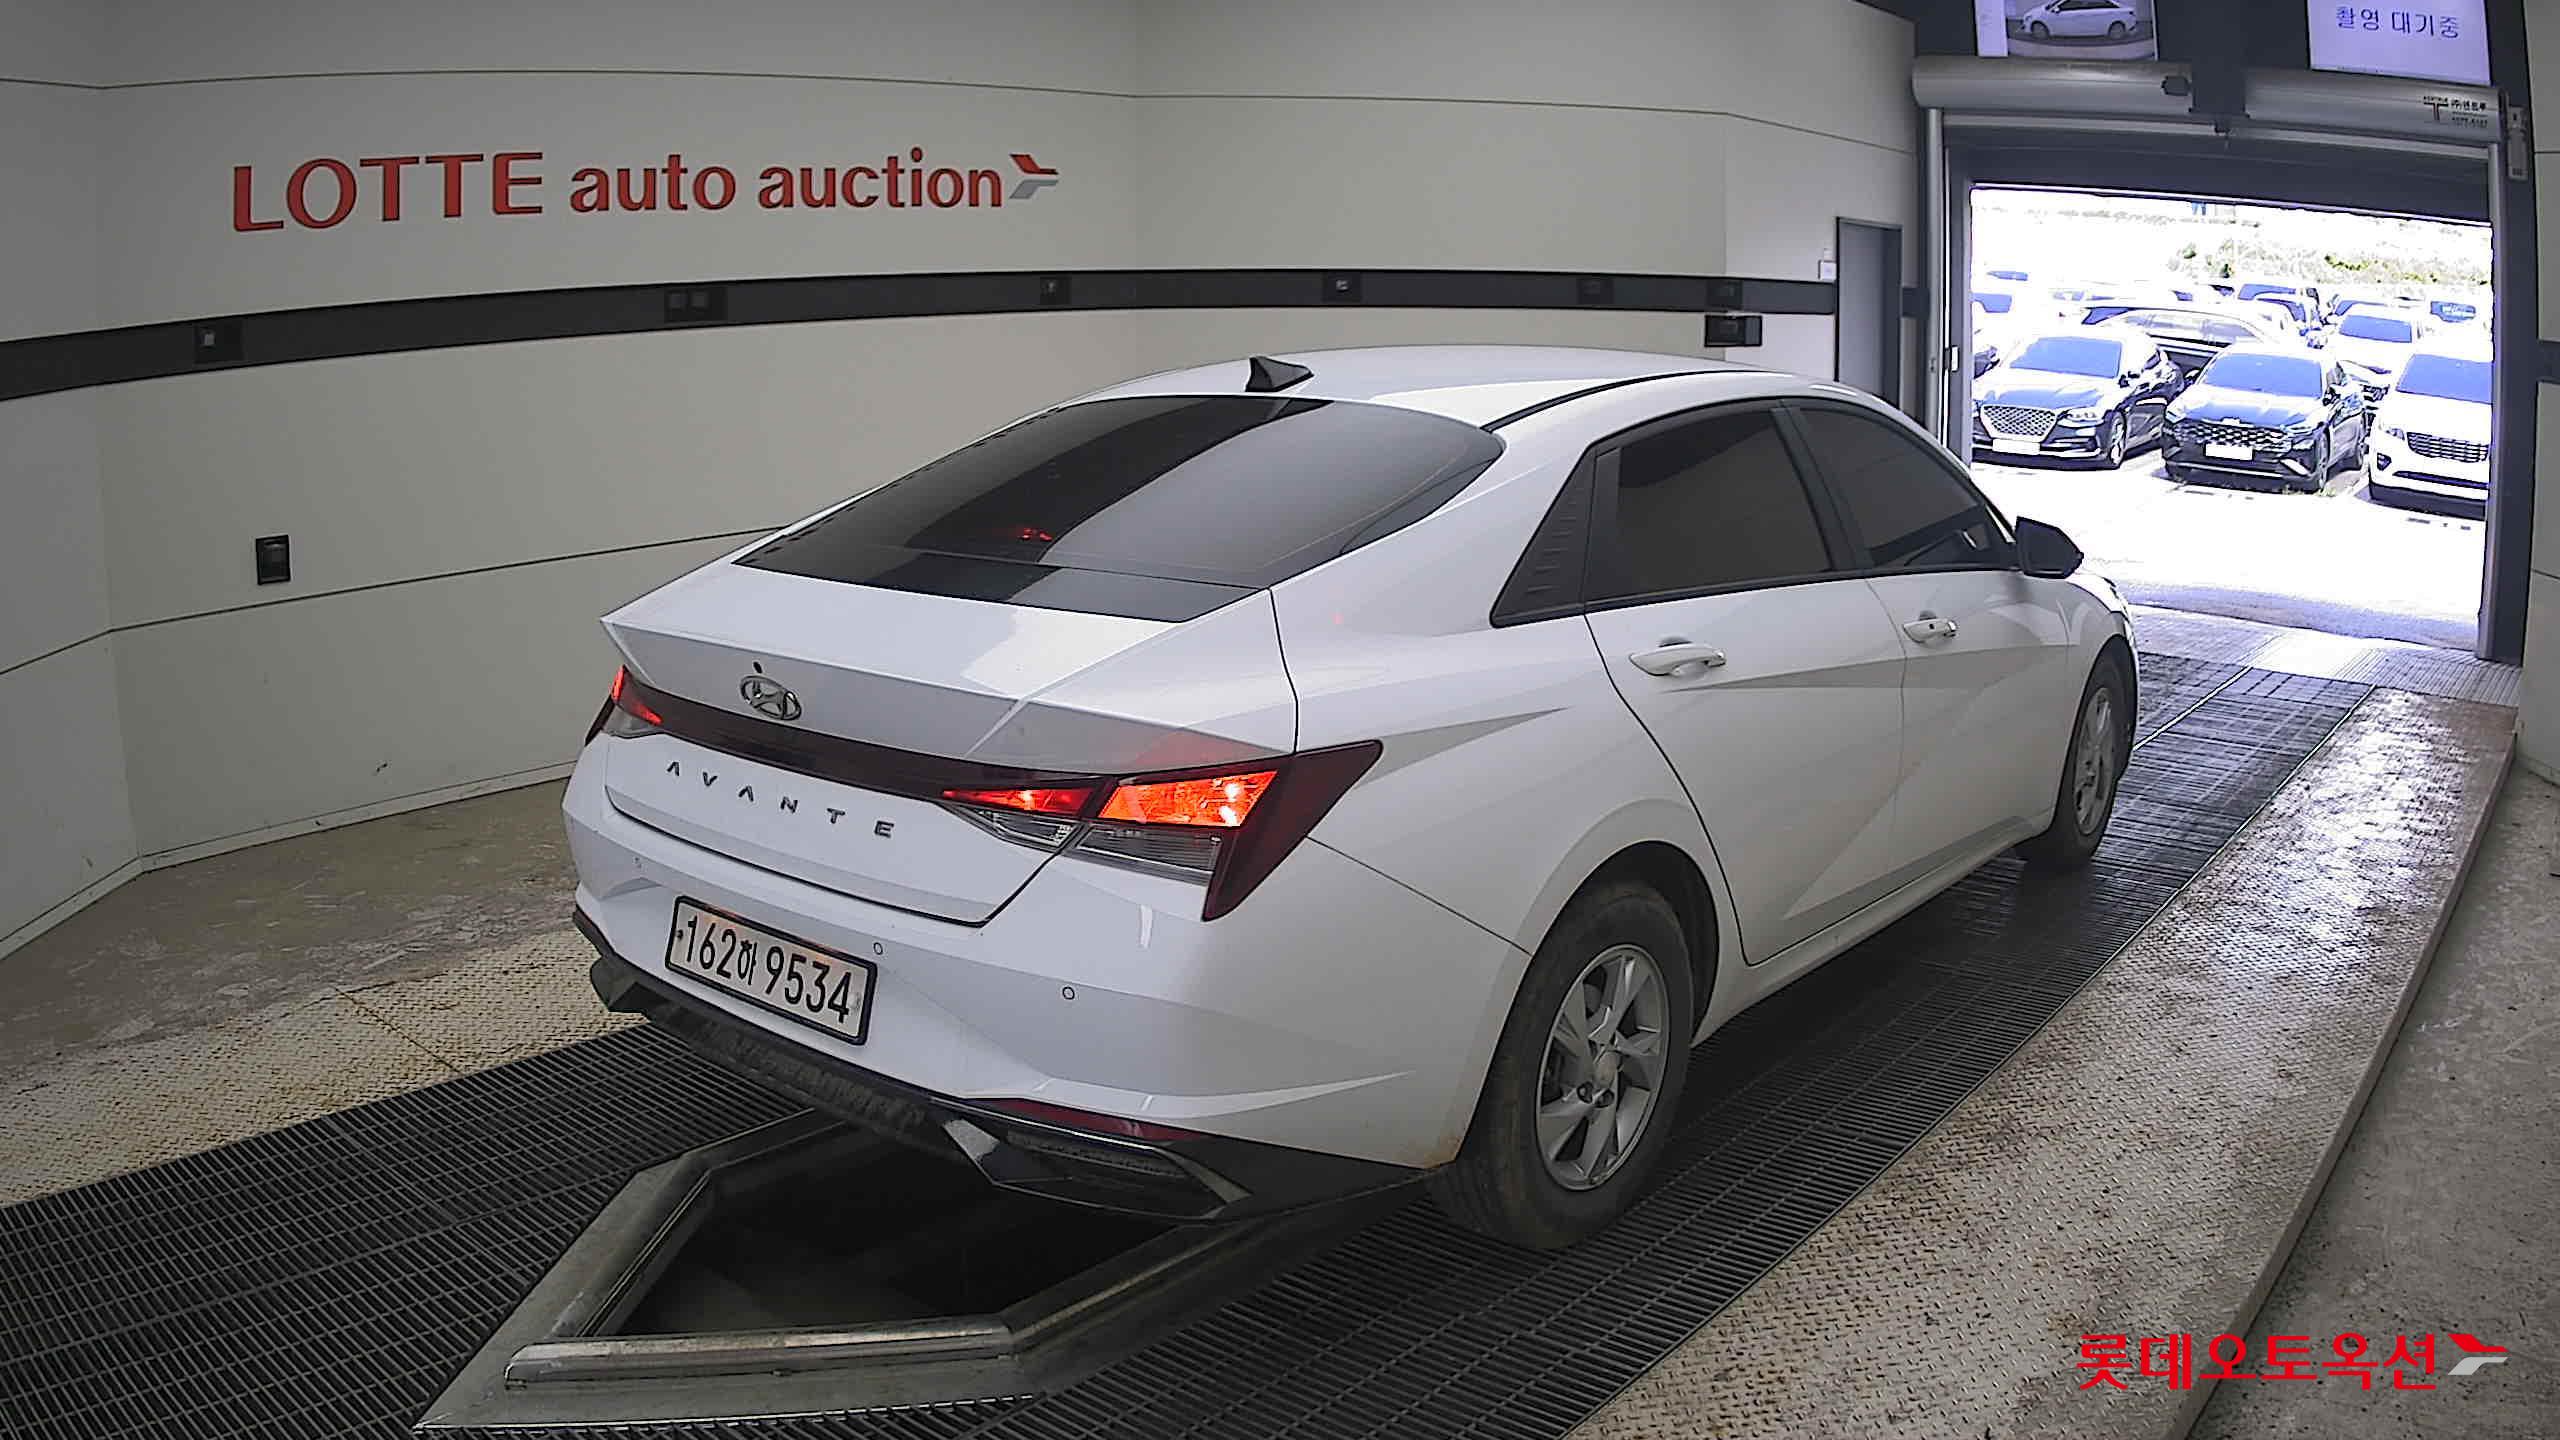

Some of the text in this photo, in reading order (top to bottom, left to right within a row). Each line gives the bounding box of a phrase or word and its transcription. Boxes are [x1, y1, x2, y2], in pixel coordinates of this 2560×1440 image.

[2336, 6, 2460, 39] 촬영 대기중
[233, 147, 1003, 232] LOTTE auto auction
[666, 760, 895, 839] AVANTE
[686, 915, 852, 1024] 162하 9534
